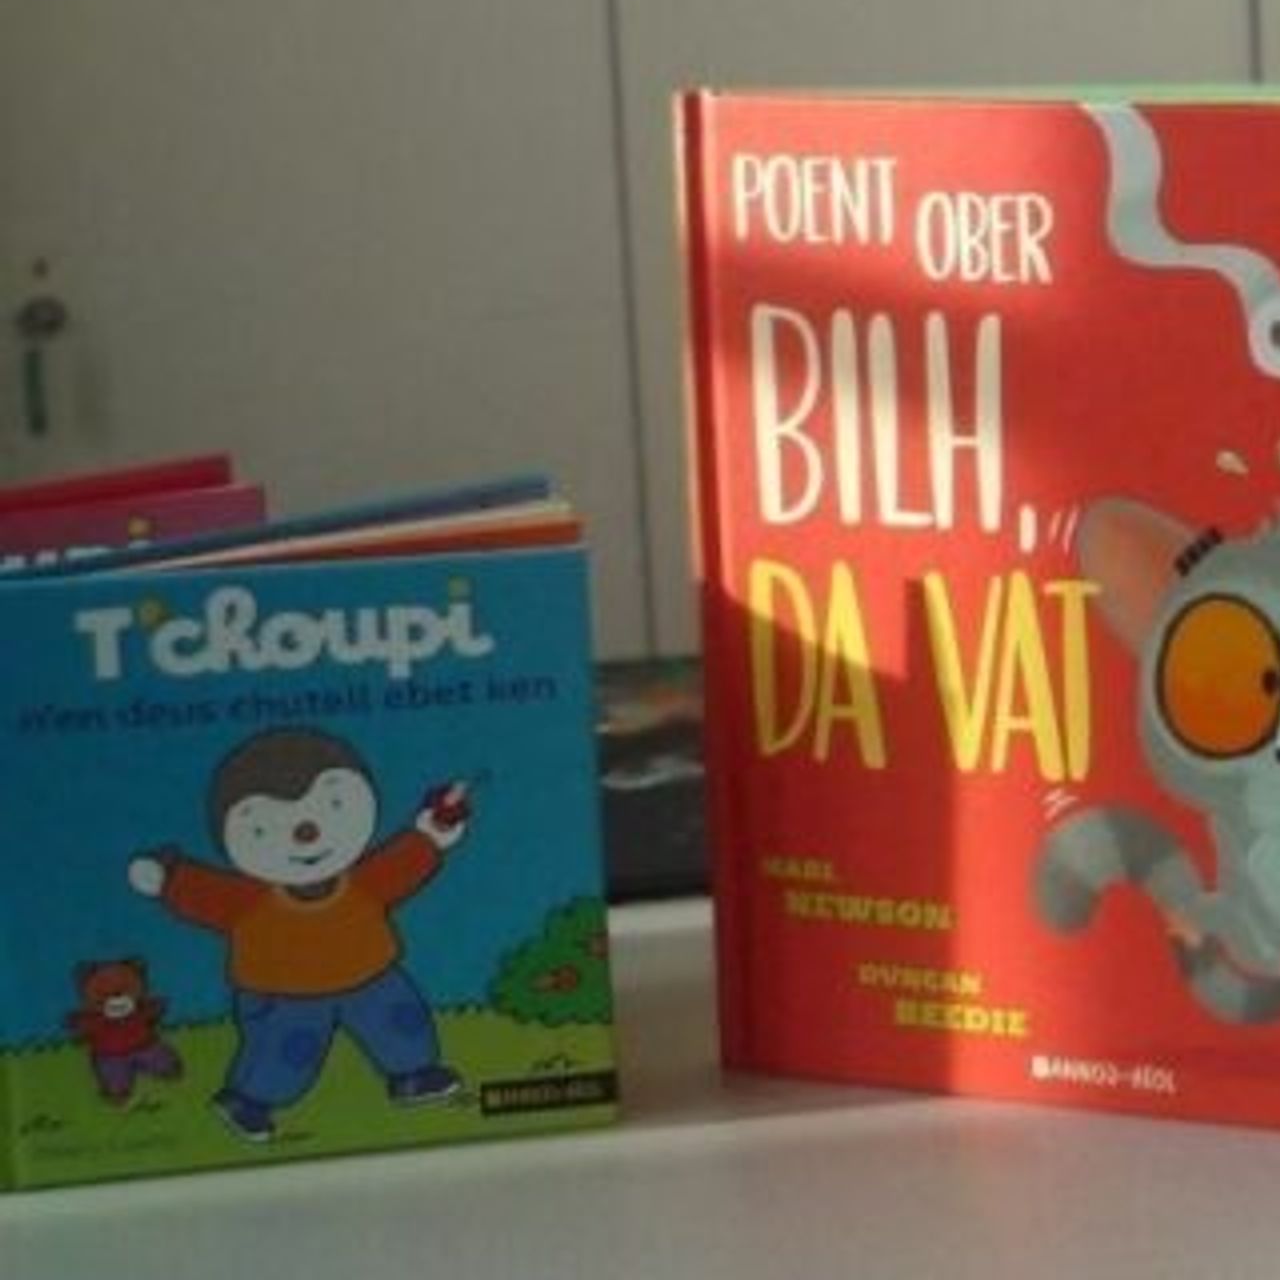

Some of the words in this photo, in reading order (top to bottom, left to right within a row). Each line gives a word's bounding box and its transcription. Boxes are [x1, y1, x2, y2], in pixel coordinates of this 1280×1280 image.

[732, 152, 897, 245] POENT
[915, 191, 1055, 284] OBER
[751, 302, 1038, 554] BILH,
[73, 574, 496, 681] T'choupi
[748, 556, 886, 770] DA
[922, 569, 1099, 783] VAT
[784, 889, 955, 931] NEWSON
